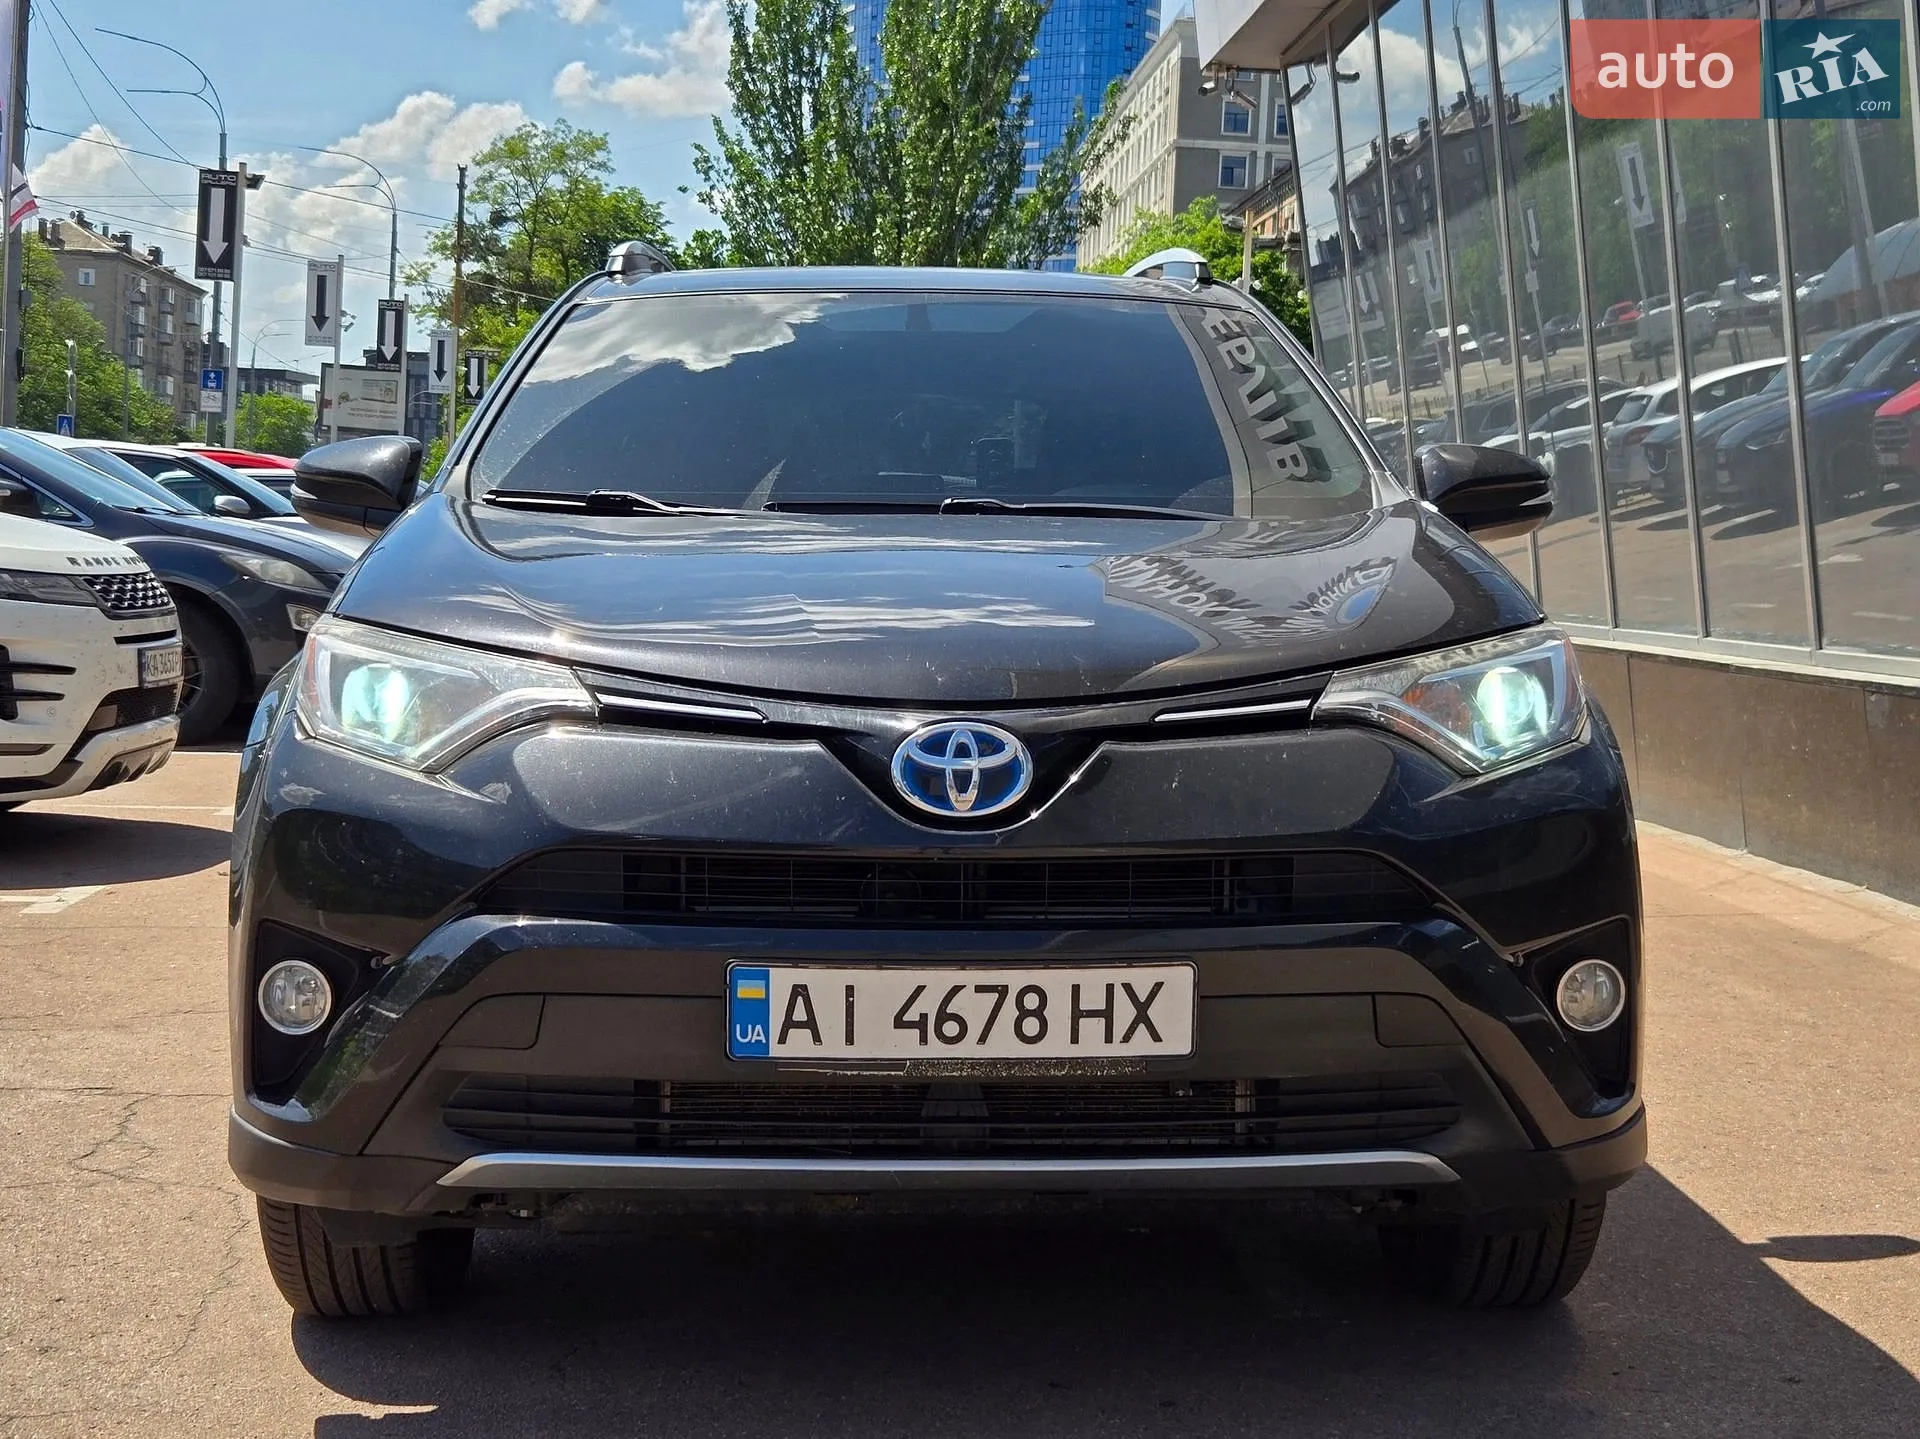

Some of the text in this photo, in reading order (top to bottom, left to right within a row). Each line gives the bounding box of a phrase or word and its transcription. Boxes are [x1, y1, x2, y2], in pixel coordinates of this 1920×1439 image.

[201, 173, 237, 181] AUTO
[777, 981, 1165, 1046] AI 4678 HX
[735, 1023, 767, 1043] UA
